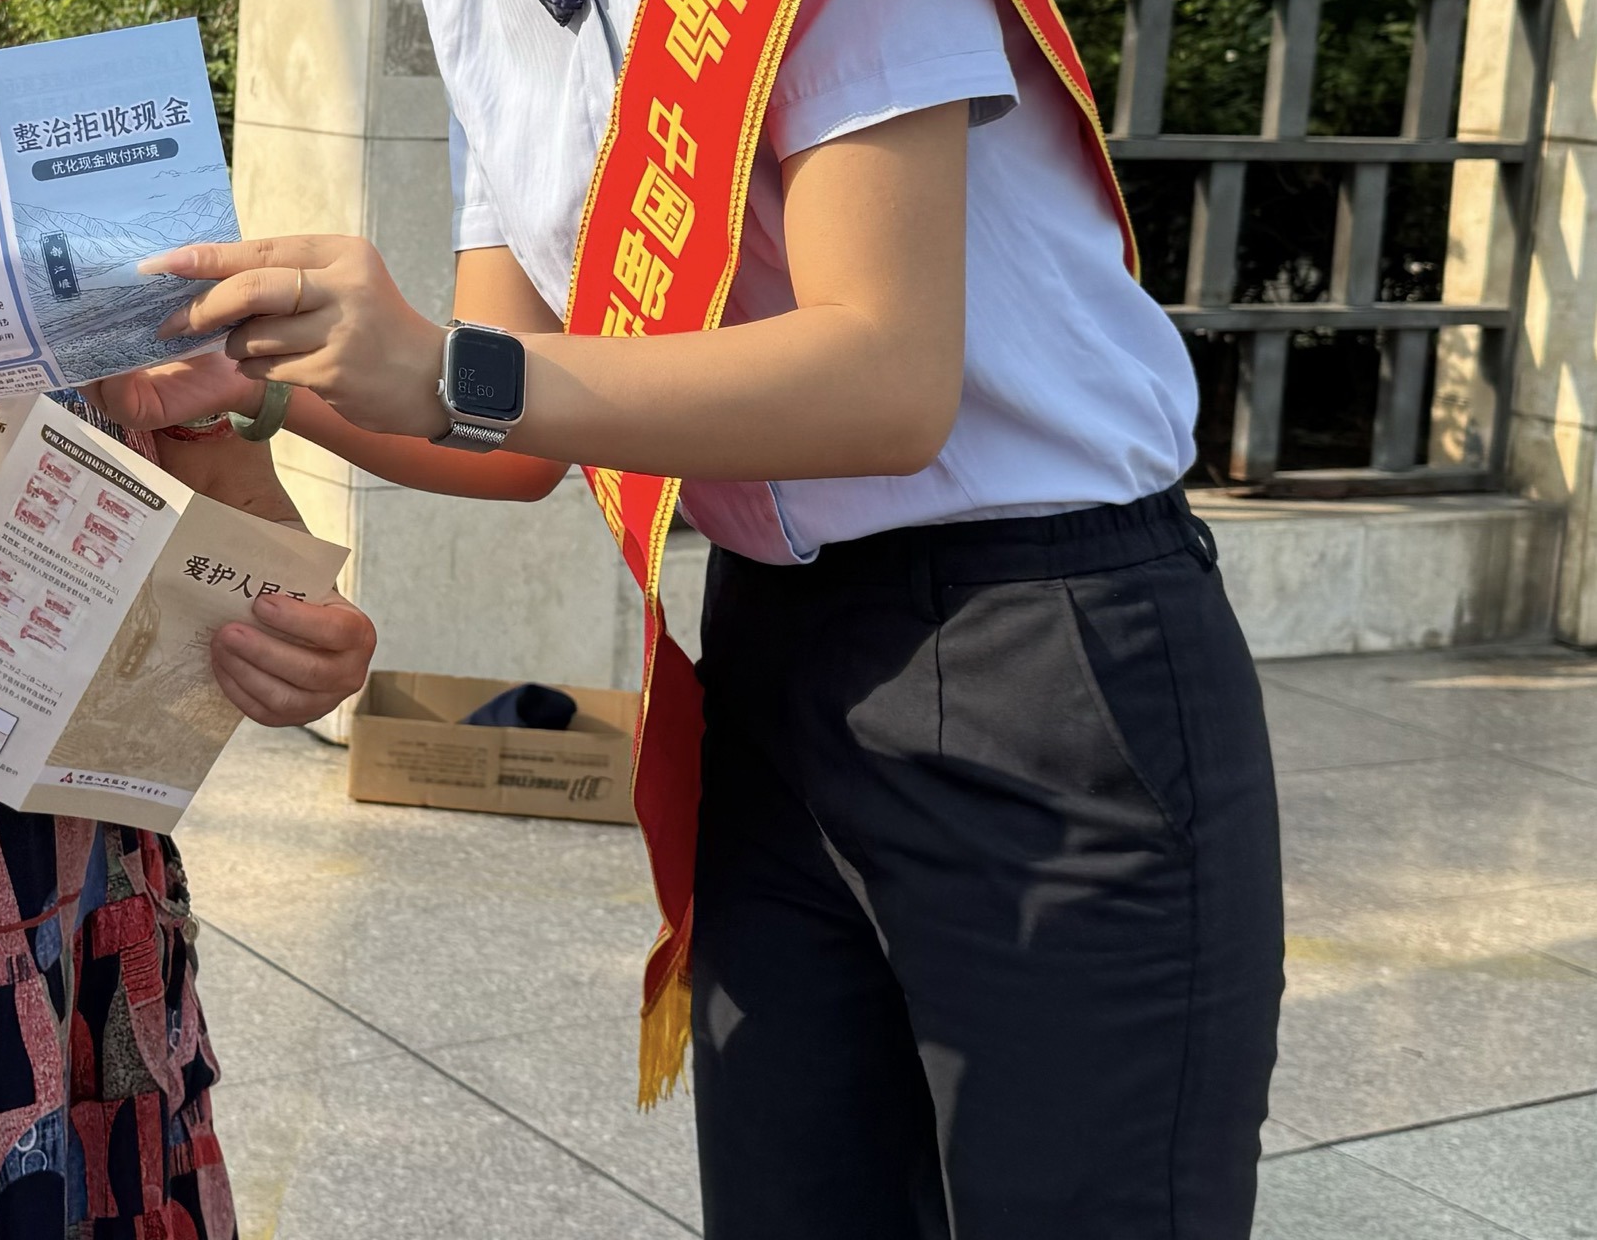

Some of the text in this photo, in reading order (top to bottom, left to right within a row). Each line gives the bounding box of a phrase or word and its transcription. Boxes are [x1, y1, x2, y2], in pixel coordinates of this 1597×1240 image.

[13, 96, 191, 153] 整治拒收现金
[52, 144, 159, 175] 优化现金收付环境
